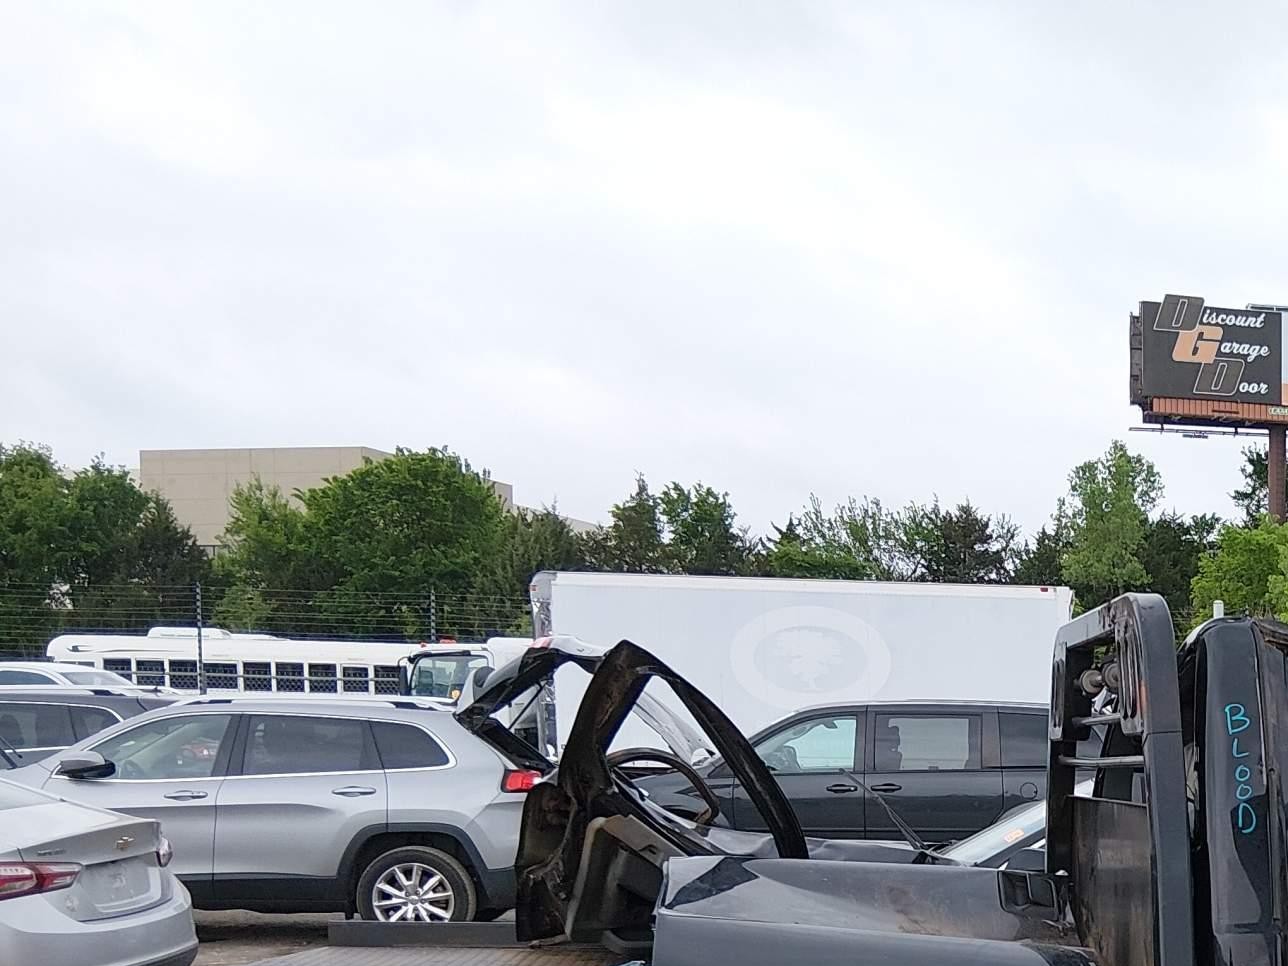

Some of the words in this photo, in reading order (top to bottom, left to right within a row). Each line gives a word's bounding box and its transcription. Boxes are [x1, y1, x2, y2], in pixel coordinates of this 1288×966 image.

[1153, 294, 1266, 332] Discount
[1172, 325, 1270, 364] Garage
[1193, 357, 1269, 396] Door
[1225, 703, 1256, 834] BLOOD
